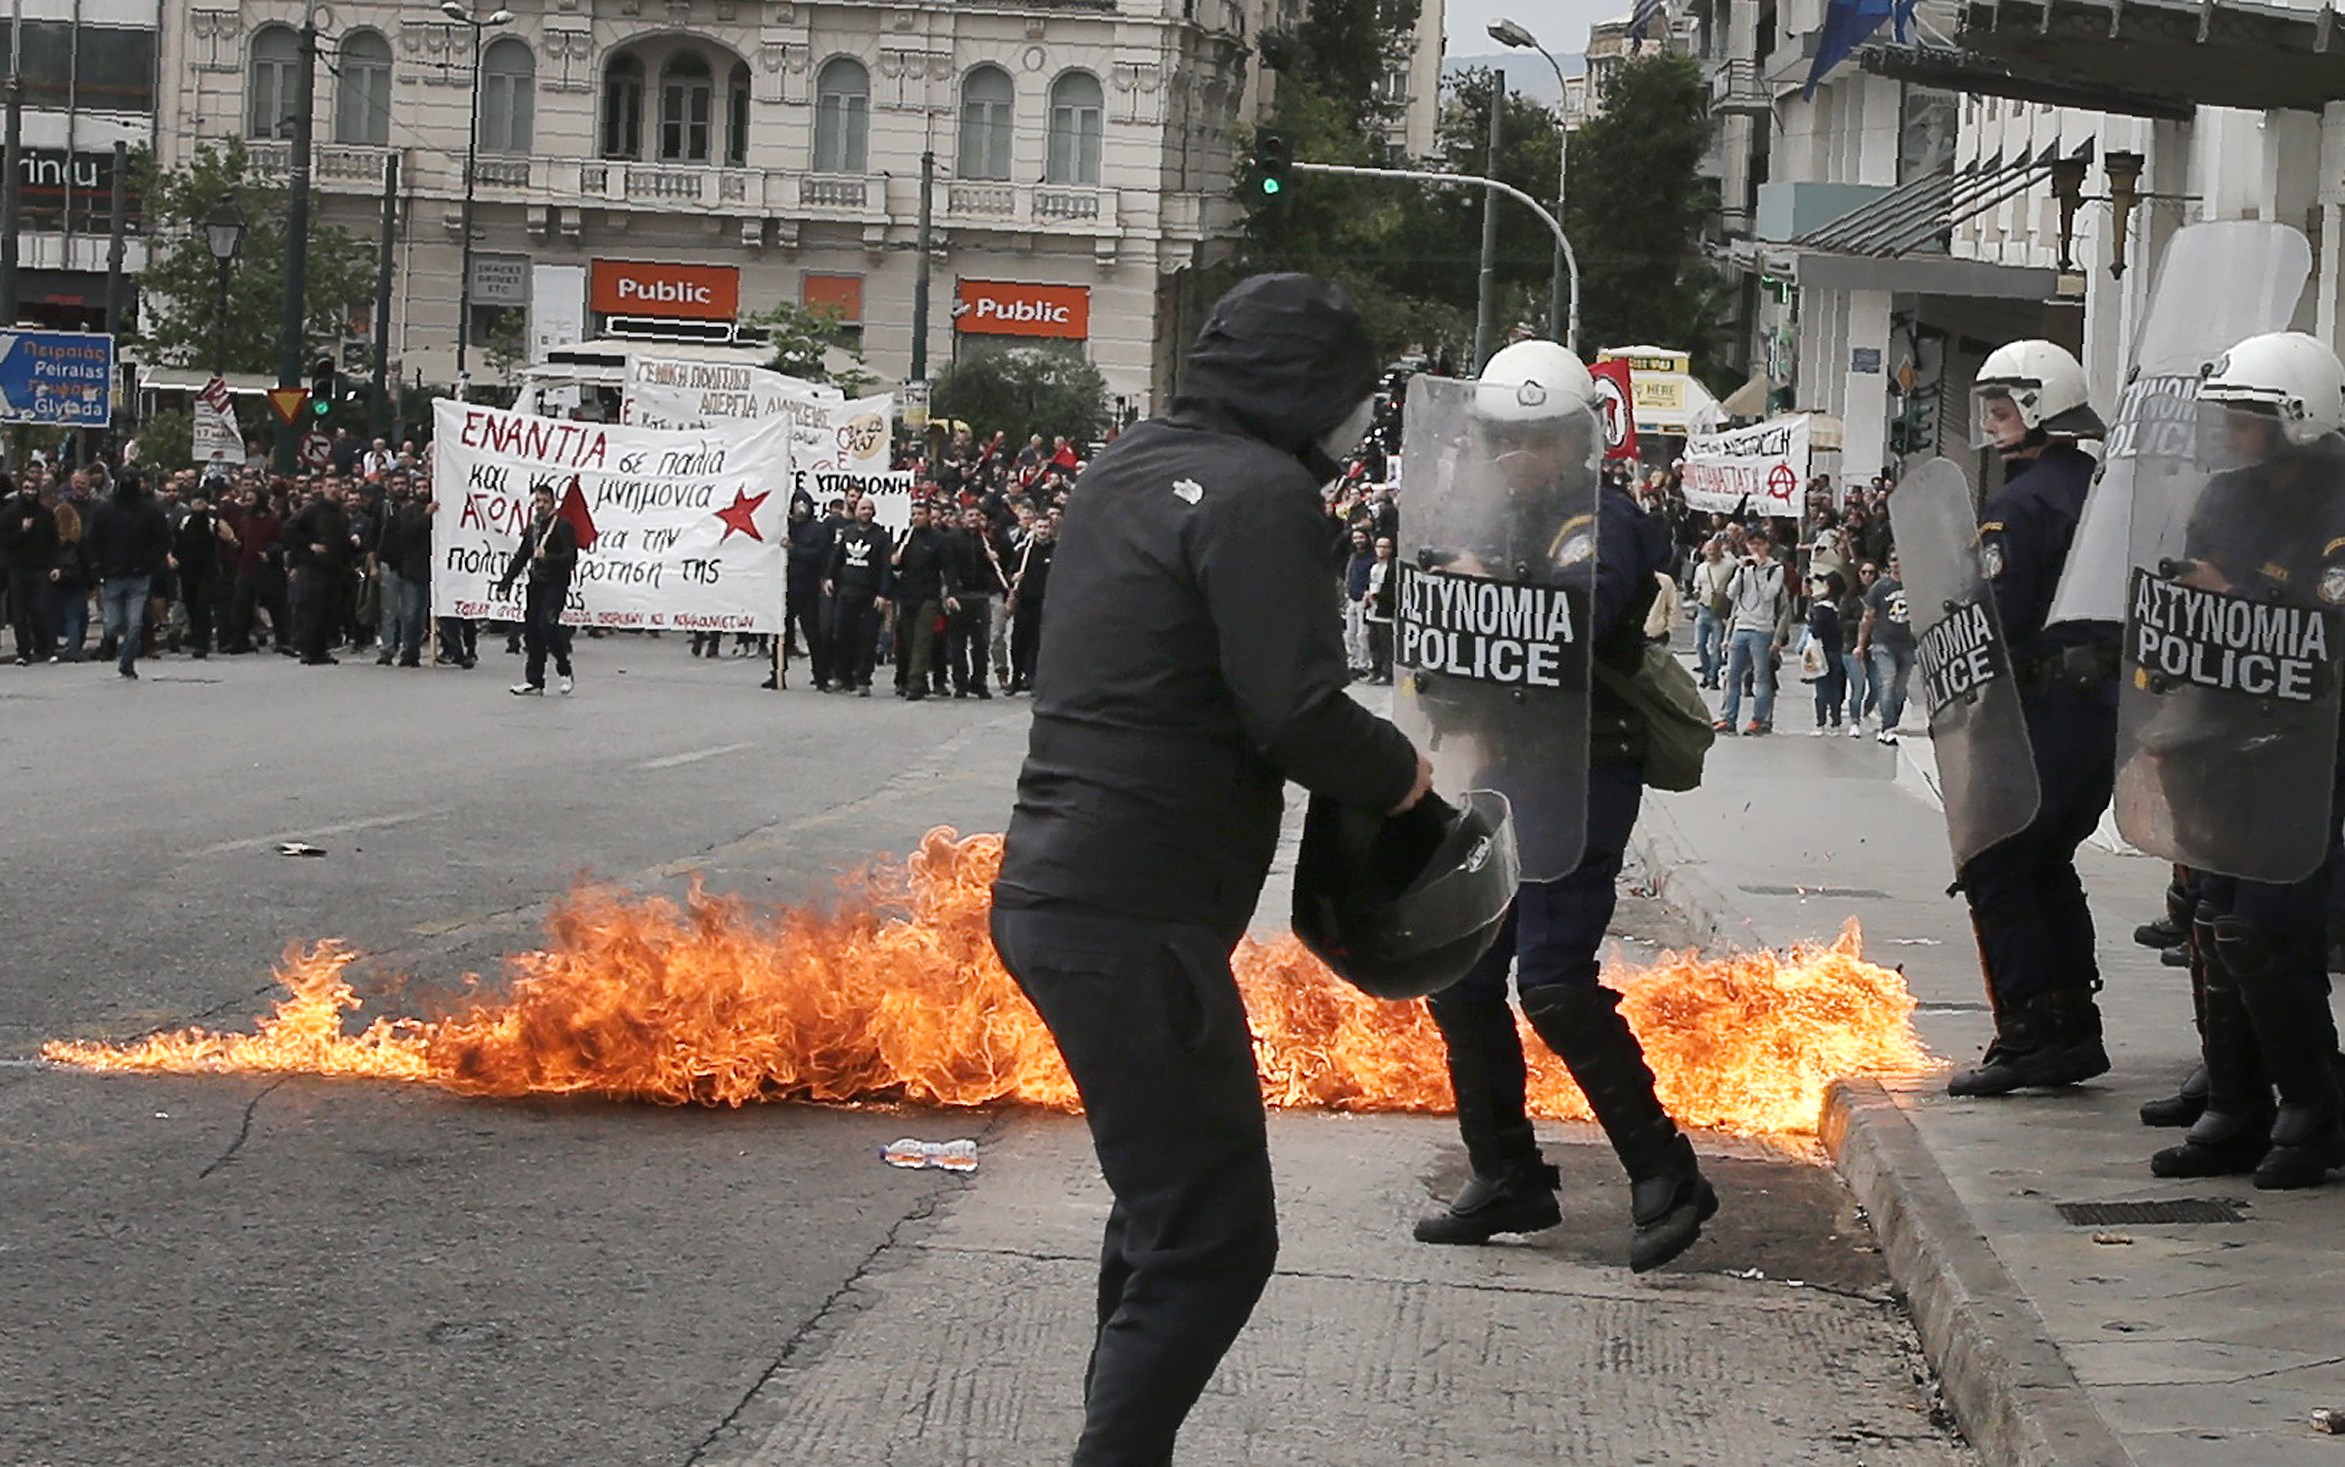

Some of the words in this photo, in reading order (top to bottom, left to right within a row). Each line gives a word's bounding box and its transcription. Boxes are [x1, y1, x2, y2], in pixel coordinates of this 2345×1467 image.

[618, 278, 711, 304] Public
[976, 298, 1069, 324] Public
[35, 361, 104, 379] Peiraias
[461, 411, 607, 468] ΕΝΑΝΤΙΑ
[619, 452, 644, 475] σε
[468, 463, 510, 494] και
[643, 528, 682, 554] την
[682, 558, 721, 584] της
[1400, 568, 1574, 642] ΑΣΤΥΝΟΜΙΑ
[2135, 572, 2327, 661] ΑΣΤΥΝΟΜΙΑ
[1403, 621, 1559, 686] POLICE
[2138, 623, 2313, 700] POLICE
